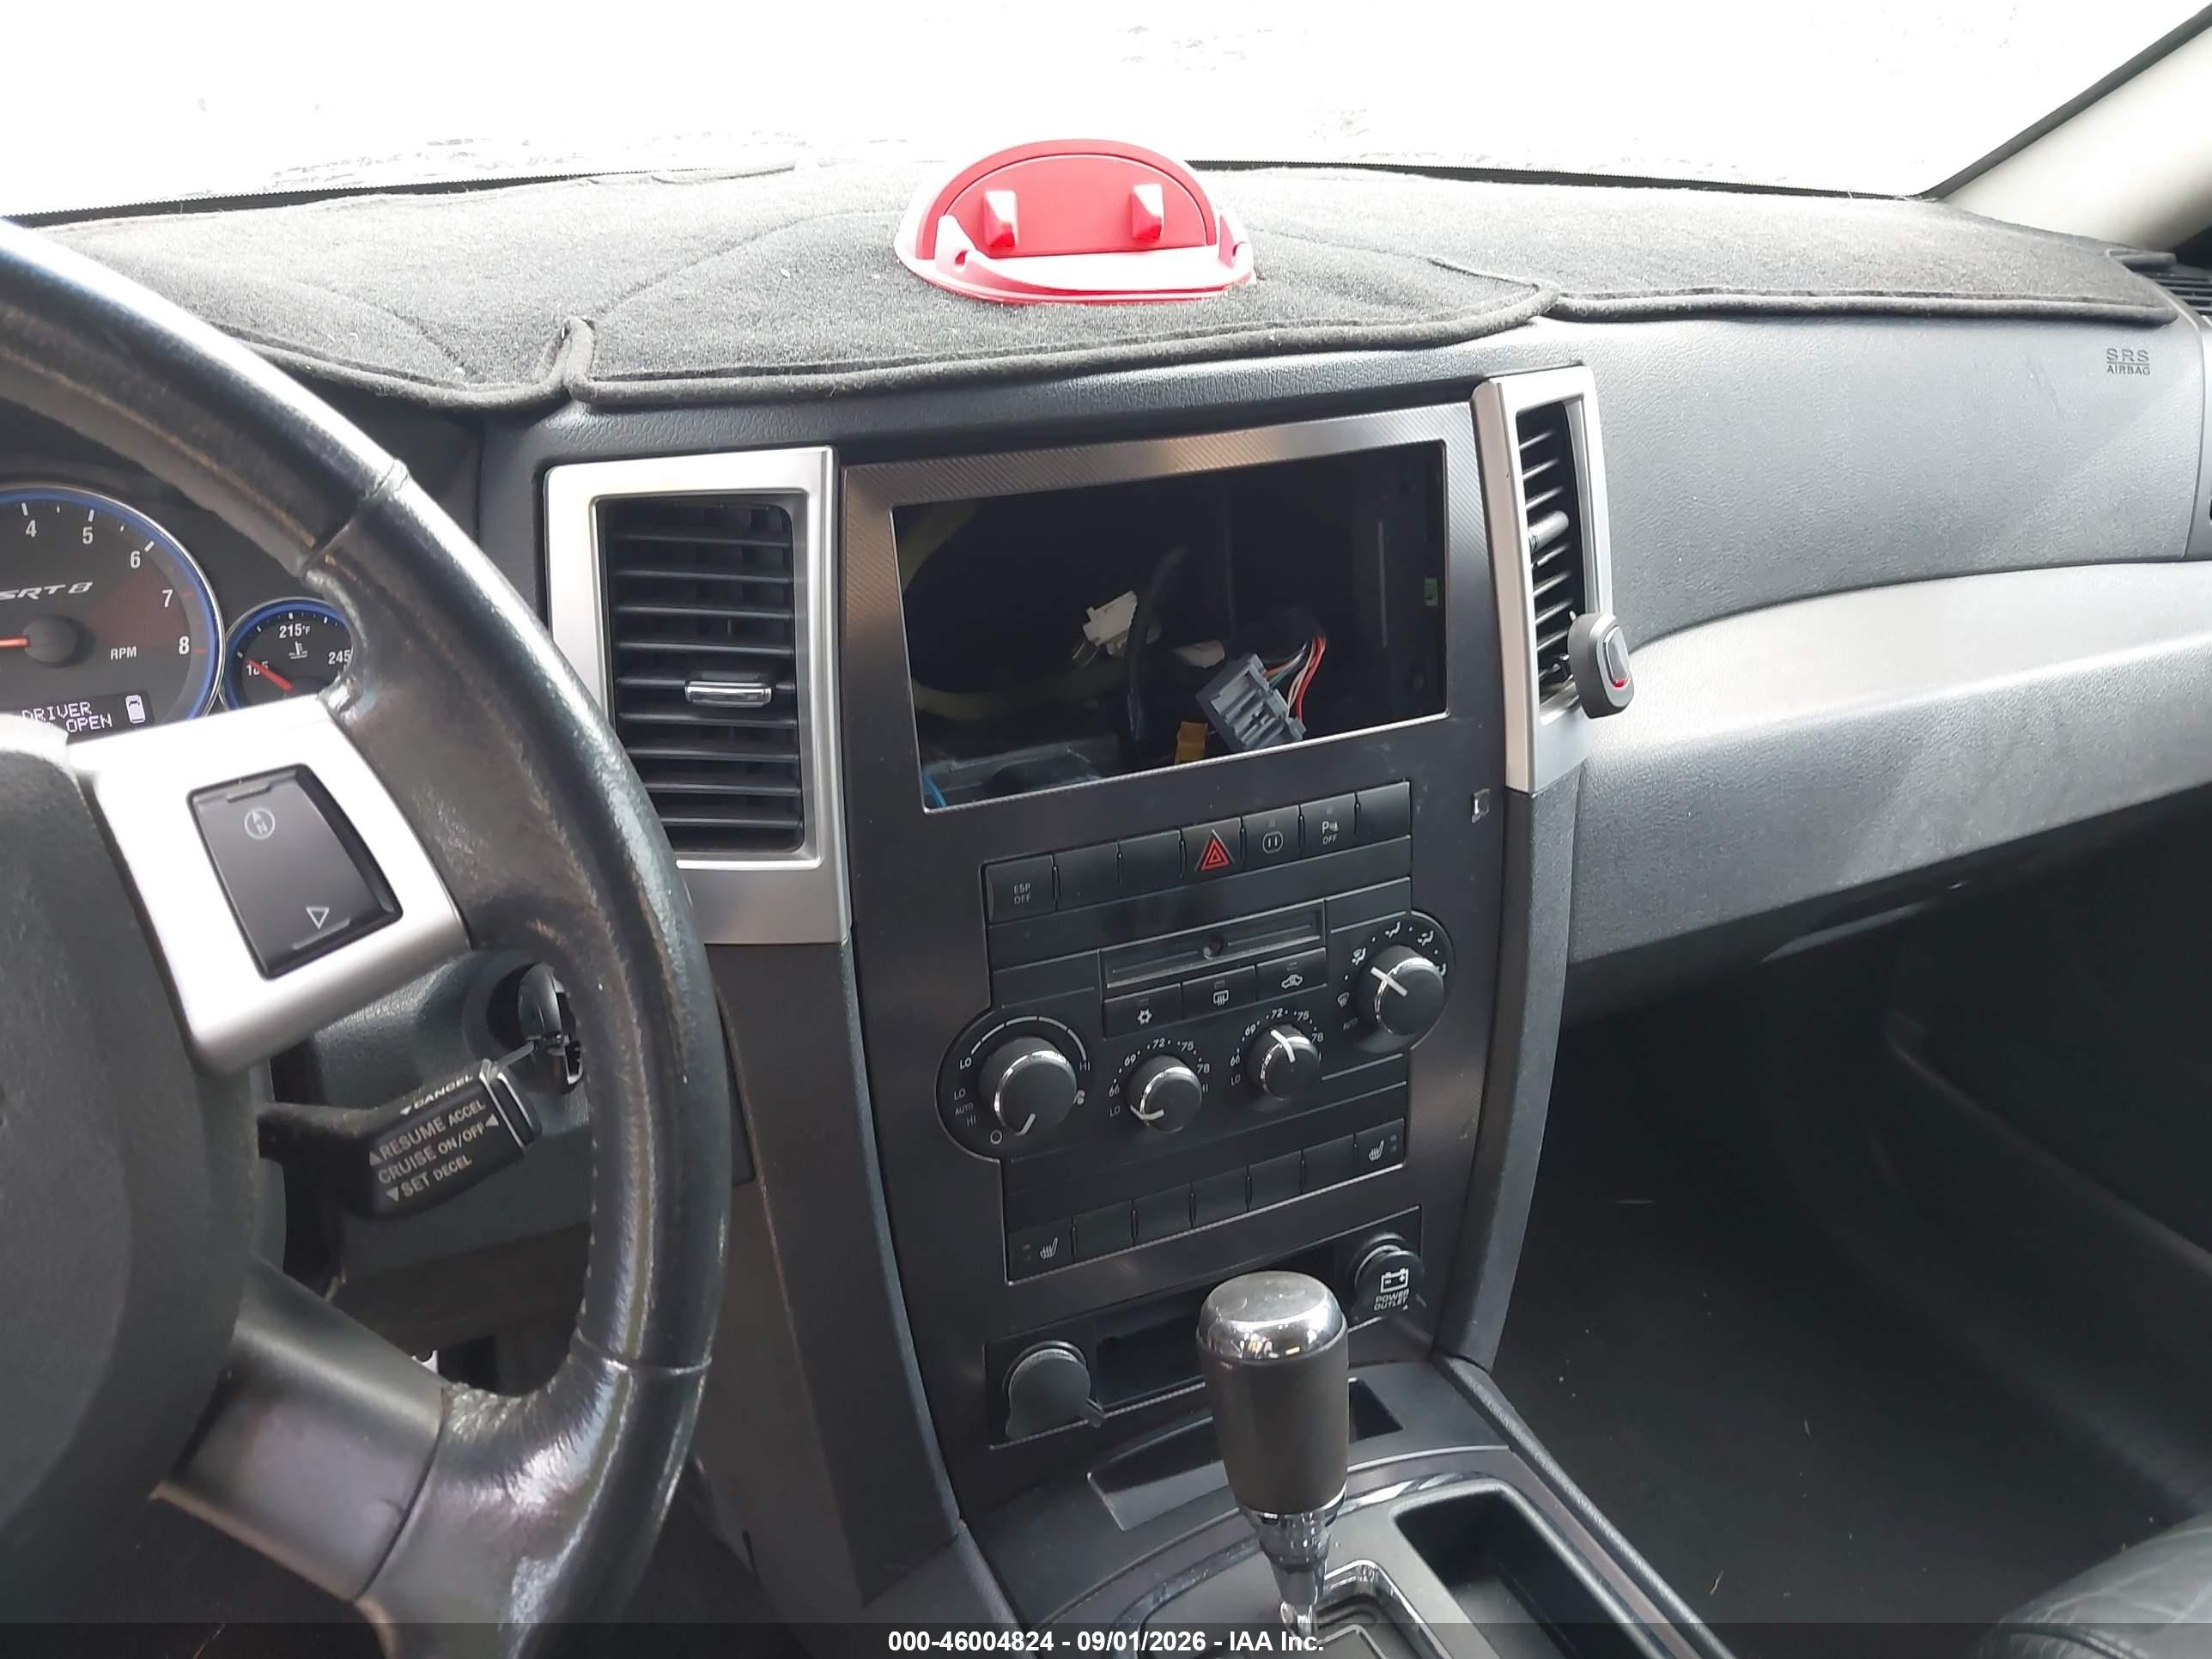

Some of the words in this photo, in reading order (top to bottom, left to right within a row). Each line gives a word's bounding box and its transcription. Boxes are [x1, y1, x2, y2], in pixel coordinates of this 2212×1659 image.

[2106, 348, 2149, 362] SRS
[2106, 364, 2151, 376] AIRBAG
[25, 519, 37, 538] 4
[82, 526, 94, 544] 5
[130, 550, 141, 568] 6
[162, 588, 173, 608] 7
[179, 636, 191, 655] 8
[110, 646, 137, 660] RPM
[328, 649, 350, 665] 245
[21, 701, 92, 722] DRIVER
[65, 713, 112, 733] OPEN
[1322, 833, 1338, 846] OFF
[1013, 882, 1031, 894] ESP
[1013, 893, 1031, 905] OFF
[1271, 1007, 1284, 1020] 72
[1244, 1024, 1256, 1036] 69
[1152, 1037, 1166, 1049] 72
[959, 1056, 973, 1071] LO
[1079, 1060, 1091, 1073] HI
[1124, 1053, 1137, 1066] 69
[1230, 1053, 1241, 1067] 66
[1231, 1073, 1242, 1086] LO
[414, 1074, 473, 1109] CANCEL
[953, 1087, 966, 1101] LO
[1109, 1084, 1121, 1097] 66
[955, 1102, 974, 1116] AUTO
[1109, 1105, 1121, 1118] LO
[966, 1113, 976, 1127] HI
[379, 1116, 447, 1161] RESUME
[448, 1099, 487, 1127] ACCEL
[378, 1145, 437, 1184] CRUISE
[438, 1121, 485, 1155] ON/OFF
[400, 1170, 430, 1198] SET
[433, 1154, 472, 1182] DECEL
[1376, 1288, 1409, 1304] POWER
[1374, 1297, 1407, 1311] OUTLET
